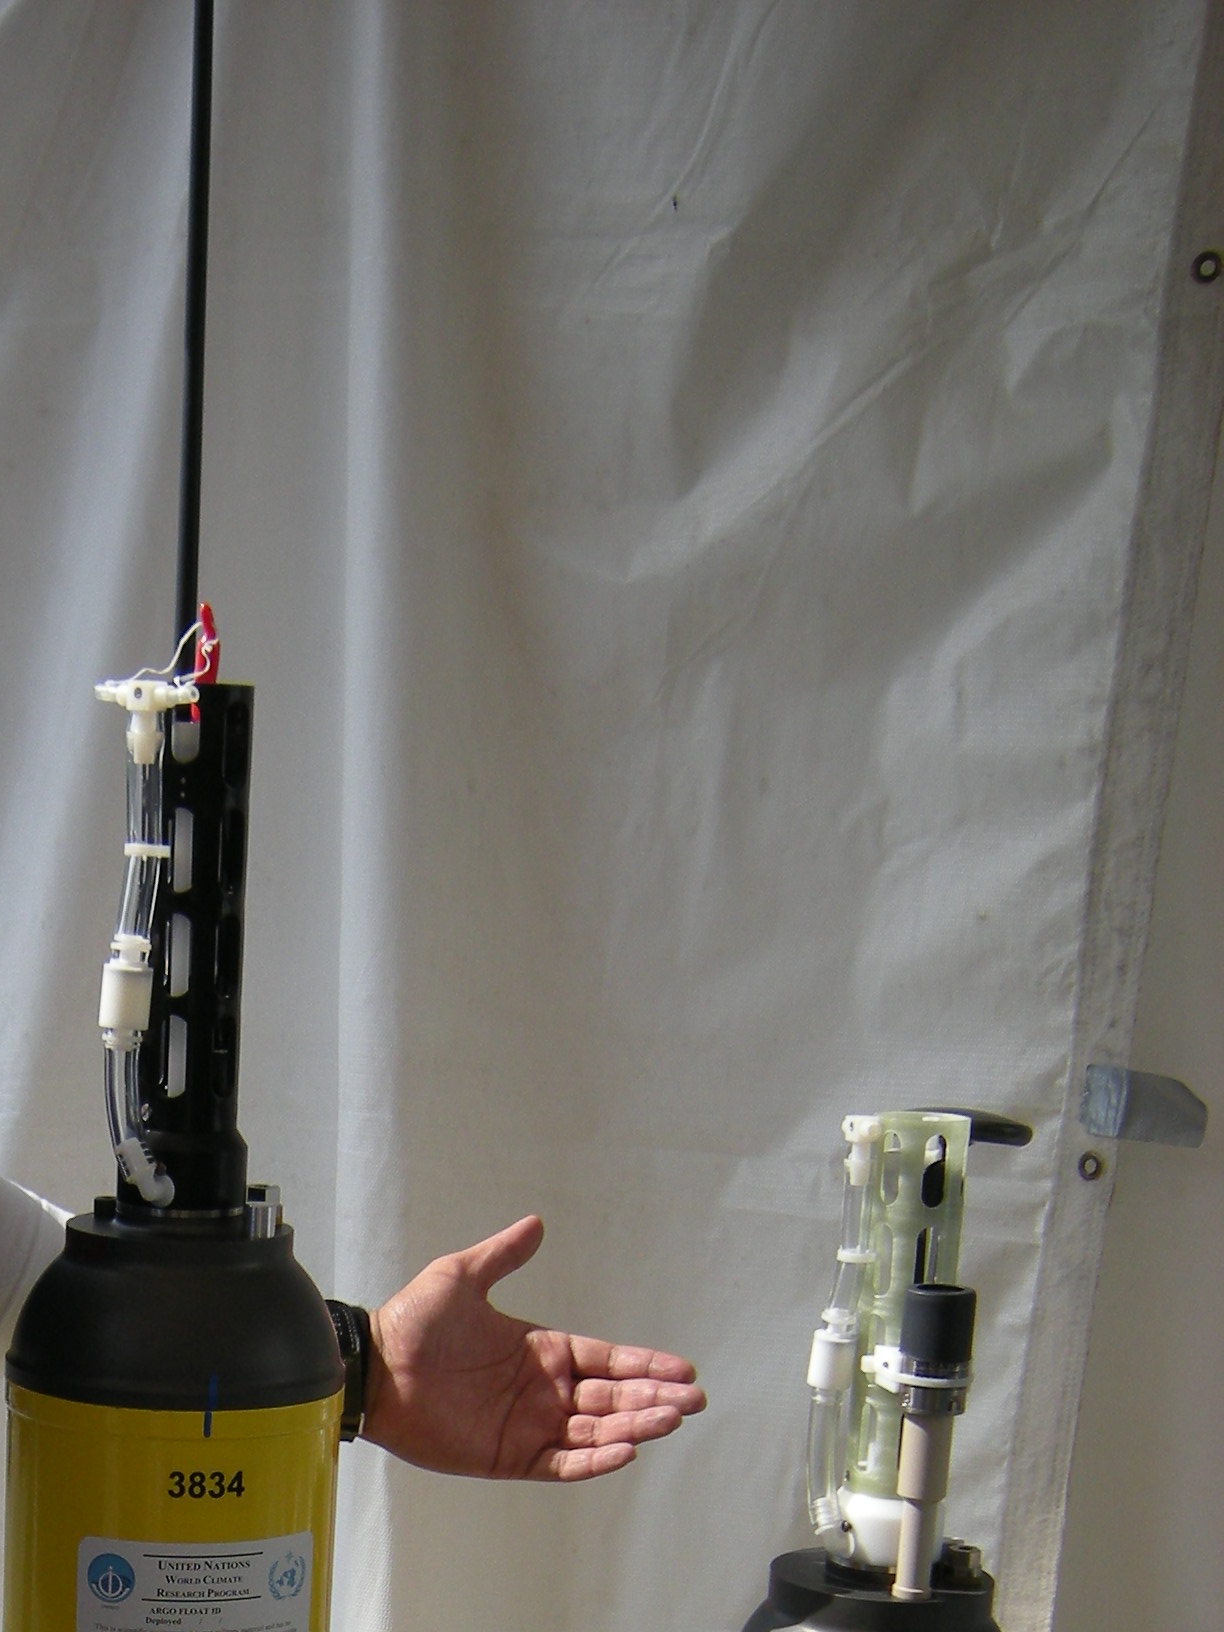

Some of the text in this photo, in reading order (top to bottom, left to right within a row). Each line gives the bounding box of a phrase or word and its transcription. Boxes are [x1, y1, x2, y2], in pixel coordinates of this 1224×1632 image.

[167, 1470, 246, 1498] 3834
[158, 1560, 251, 1571] UNITED NATIONS
[165, 1574, 243, 1585] WORLD CLIMATE
[156, 1588, 250, 1598] RESEARCH PROGRAM
[151, 1607, 177, 1615] ARGO
[179, 1607, 209, 1615] FLOAT
[145, 1616, 182, 1626] Deployed
